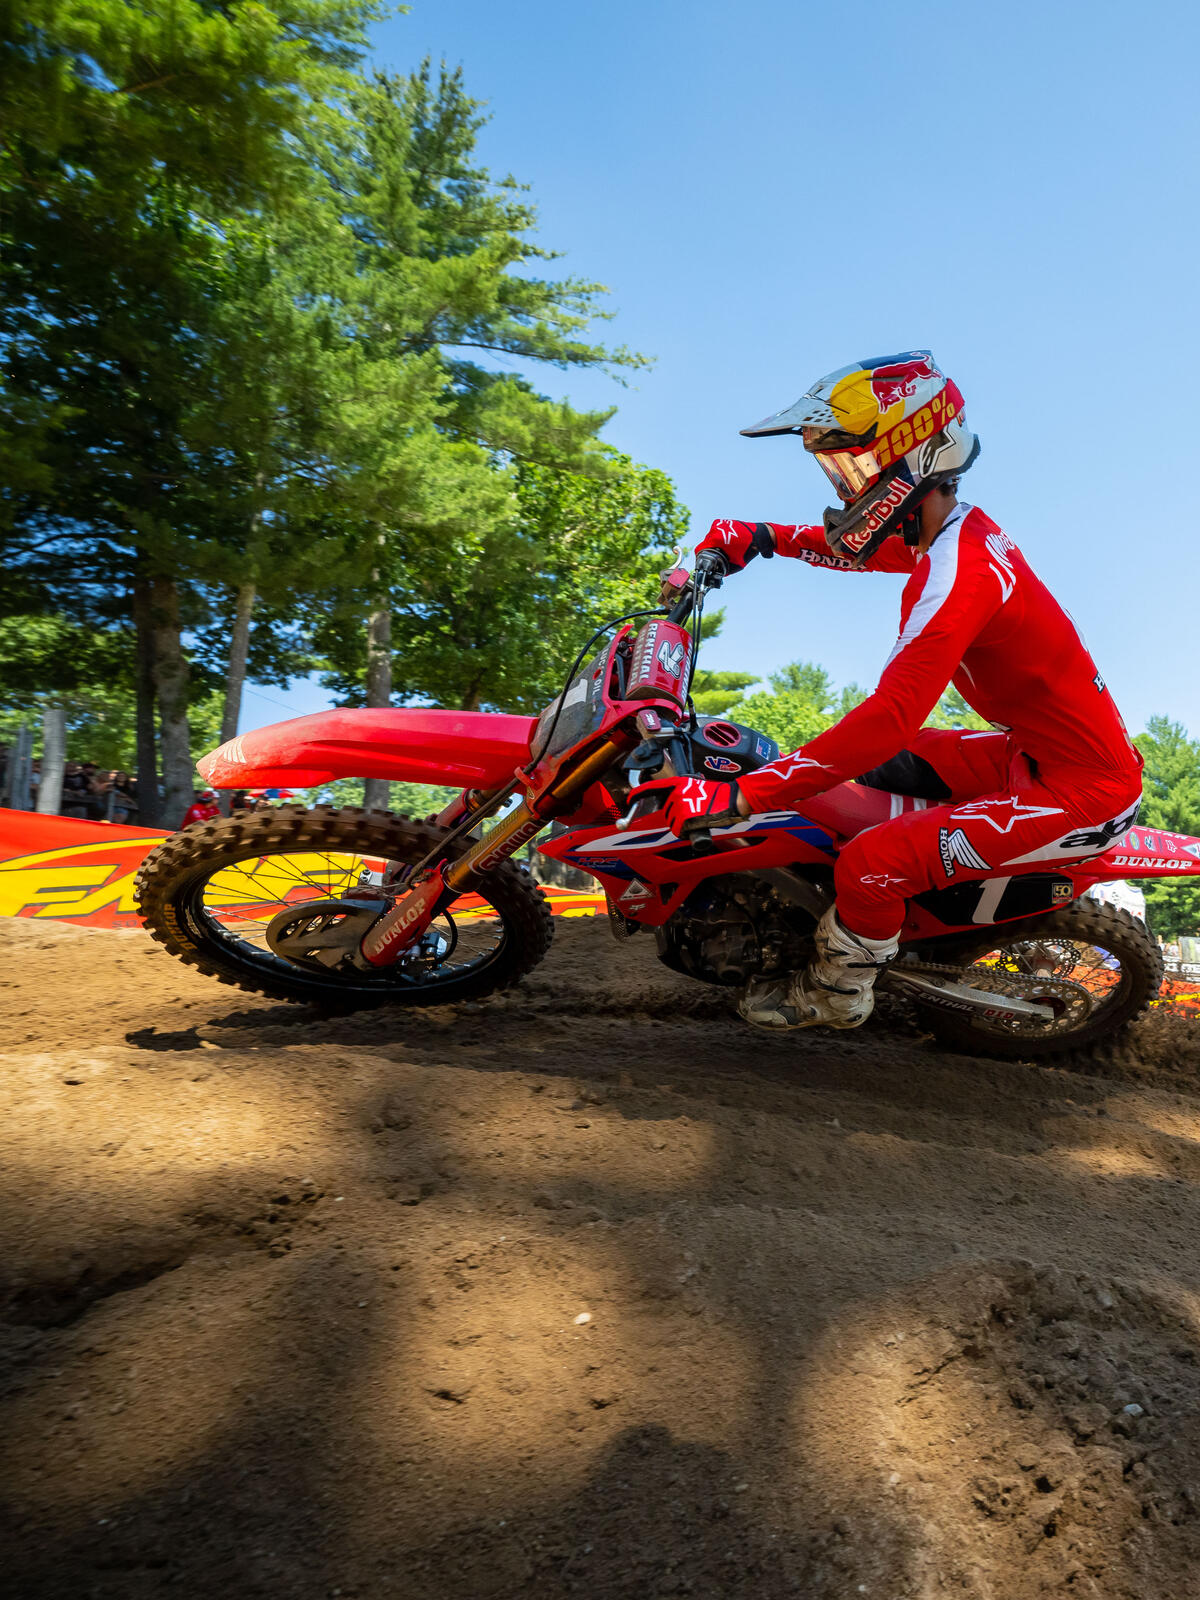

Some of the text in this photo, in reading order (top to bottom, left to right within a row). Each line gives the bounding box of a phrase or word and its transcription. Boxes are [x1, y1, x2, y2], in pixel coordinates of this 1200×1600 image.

[873, 390, 955, 467] 100%
[640, 622, 659, 680] RENTHAL
[592, 679, 602, 696] OIL
[706, 756, 732, 770] VP
[940, 828, 955, 877] HONDA
[1111, 855, 1193, 870] DUNLOP
[972, 876, 1013, 924] 1
[1054, 885, 1071, 896] 50
[374, 897, 427, 955] DUNLOP
